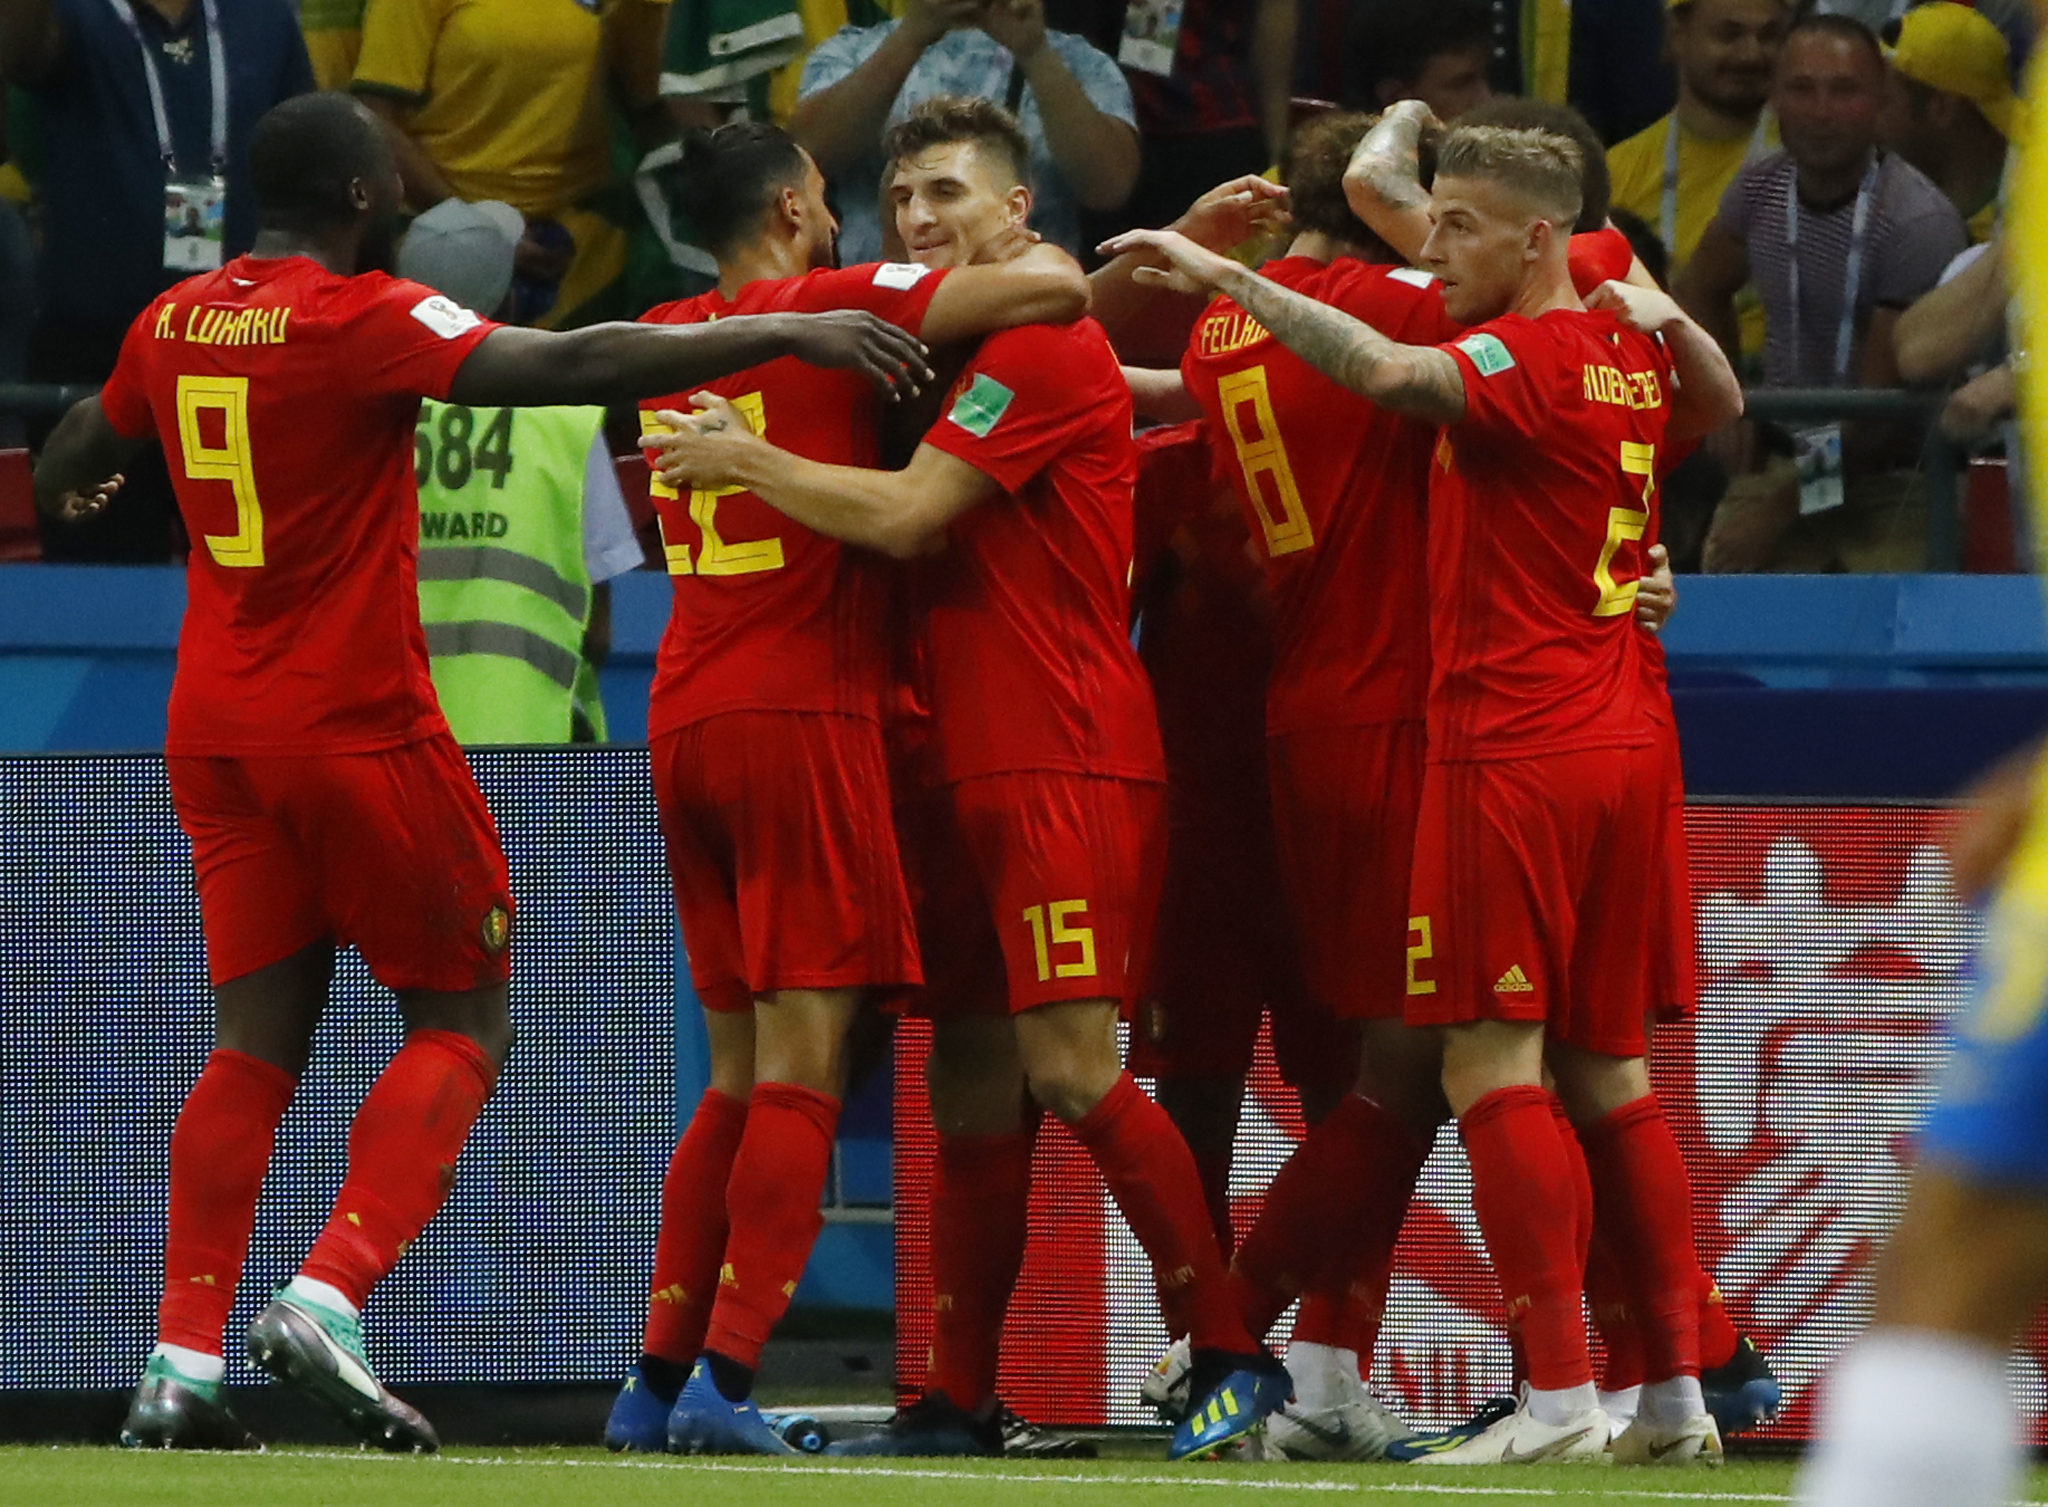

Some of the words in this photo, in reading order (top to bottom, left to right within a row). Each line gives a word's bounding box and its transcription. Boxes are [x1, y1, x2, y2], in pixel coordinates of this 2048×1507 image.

[184, 304, 292, 346] LUKAKU
[176, 374, 266, 568] 9
[1217, 364, 1315, 558] 8
[1591, 440, 1656, 617] 2
[1022, 898, 1098, 982] 15
[1406, 915, 1437, 995] 2
[1493, 982, 1534, 993] adidas
